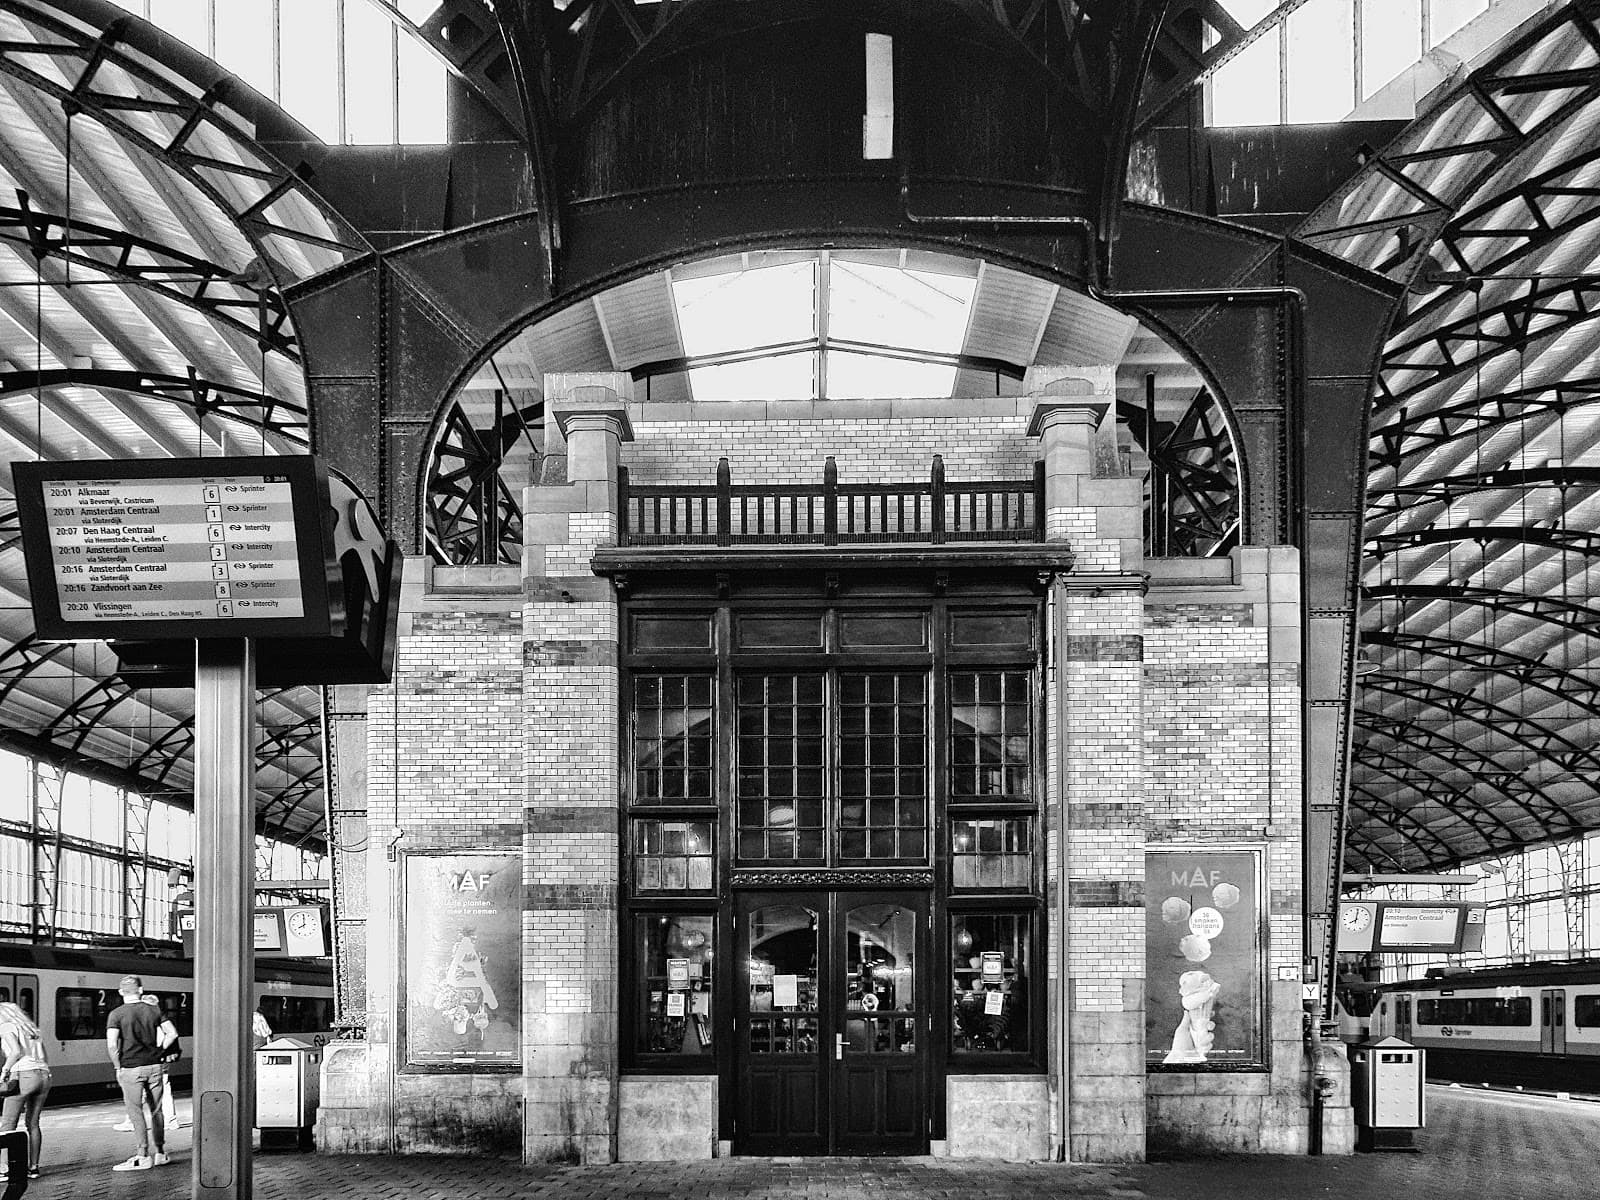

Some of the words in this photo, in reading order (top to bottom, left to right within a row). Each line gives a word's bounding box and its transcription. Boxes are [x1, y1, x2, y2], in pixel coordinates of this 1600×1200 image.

[50, 488, 72, 497] 20:01
[78, 488, 110, 496] Alkmaar
[209, 490, 215, 499] 6
[240, 485, 265, 493] Sprinter
[53, 508, 75, 516] 20:01
[80, 507, 125, 516] Amsterdam
[127, 505, 160, 515] Centraal
[211, 509, 216, 518] 1
[242, 505, 267, 513] Sprinter
[56, 527, 77, 536] 20:07
[82, 527, 98, 535] Den
[100, 526, 120, 536] Haag
[122, 525, 155, 534] Centraal
[213, 528, 219, 538] 6
[244, 523, 271, 532] Intercity
[59, 546, 81, 555] 20:10
[86, 546, 130, 554] Amsterdam
[132, 544, 165, 553] Centraal
[216, 548, 221, 557] 3
[246, 543, 273, 551] Intercity
[62, 565, 83, 573] 20:16
[88, 564, 133, 573] Amsterdam
[135, 563, 167, 572] Centraal
[218, 567, 224, 576] 3
[248, 562, 274, 570] Sprinter
[64, 584, 86, 592] 20:16
[91, 583, 131, 592] Zandvoort
[148, 583, 163, 591] Zee
[220, 586, 226, 594] 8
[250, 581, 276, 589] Sprinter
[67, 603, 88, 611] 20:20
[92, 602, 132, 611] Vlissingen
[222, 604, 228, 613] 6
[253, 600, 279, 608] Intercity
[1171, 866, 1221, 888] MAF
[98, 990, 106, 1006] 2
[1306, 986, 1316, 997] Y
[180, 992, 188, 1008] 2
[281, 996, 288, 1010] 2
